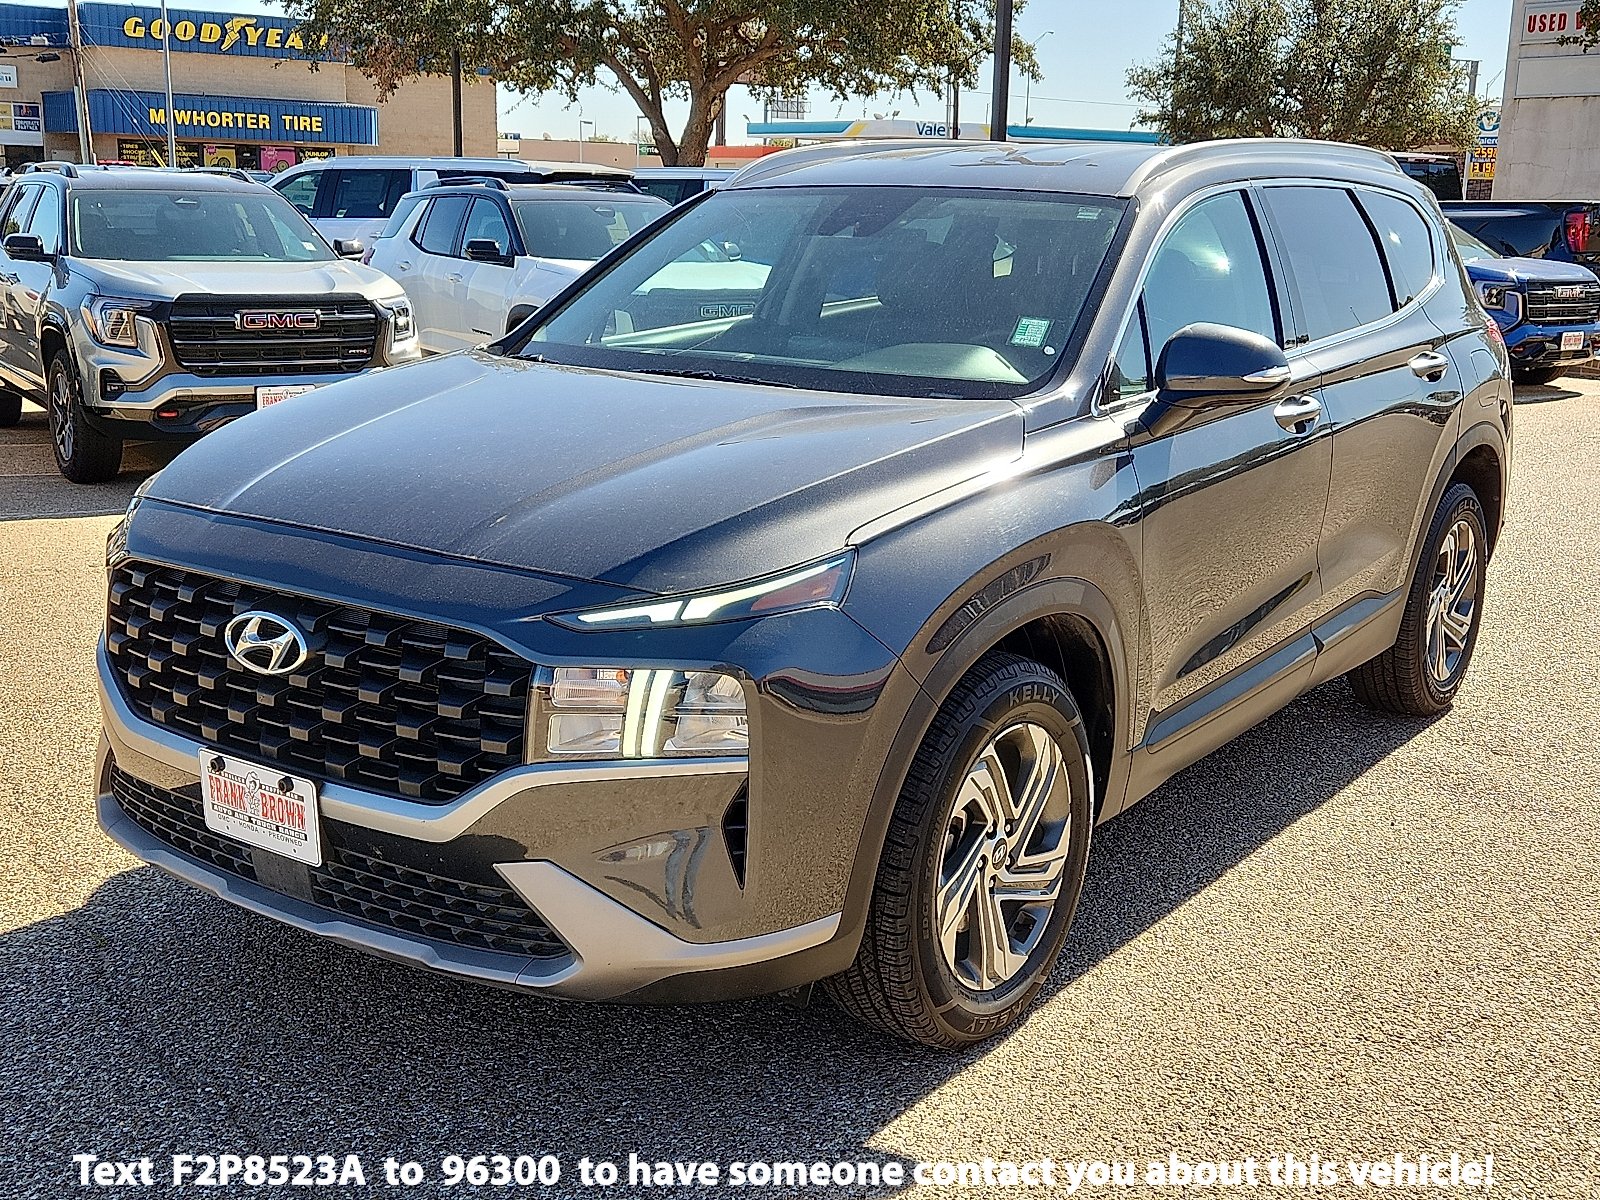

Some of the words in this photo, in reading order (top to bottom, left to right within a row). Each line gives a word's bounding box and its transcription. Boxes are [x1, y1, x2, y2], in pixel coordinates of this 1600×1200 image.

[123, 16, 328, 50] GOODYEA
[1527, 12, 1567, 33] USED
[150, 107, 270, 130] MWHORTER
[281, 115, 323, 132] TIRE
[243, 313, 318, 328] GMC
[700, 304, 754, 318] GMC
[1008, 684, 1060, 708] KELLY
[208, 774, 248, 814] FRANK
[260, 792, 307, 831] BROWN
[213, 804, 232, 816] AUTO
[234, 812, 250, 822] AND
[251, 817, 277, 831] TRUCK
[278, 826, 306, 840] RANCH
[217, 813, 231, 823] GMC
[238, 820, 260, 834] HONDA
[924, 800, 948, 881] TOURING
[964, 999, 1024, 1032] KELLY
